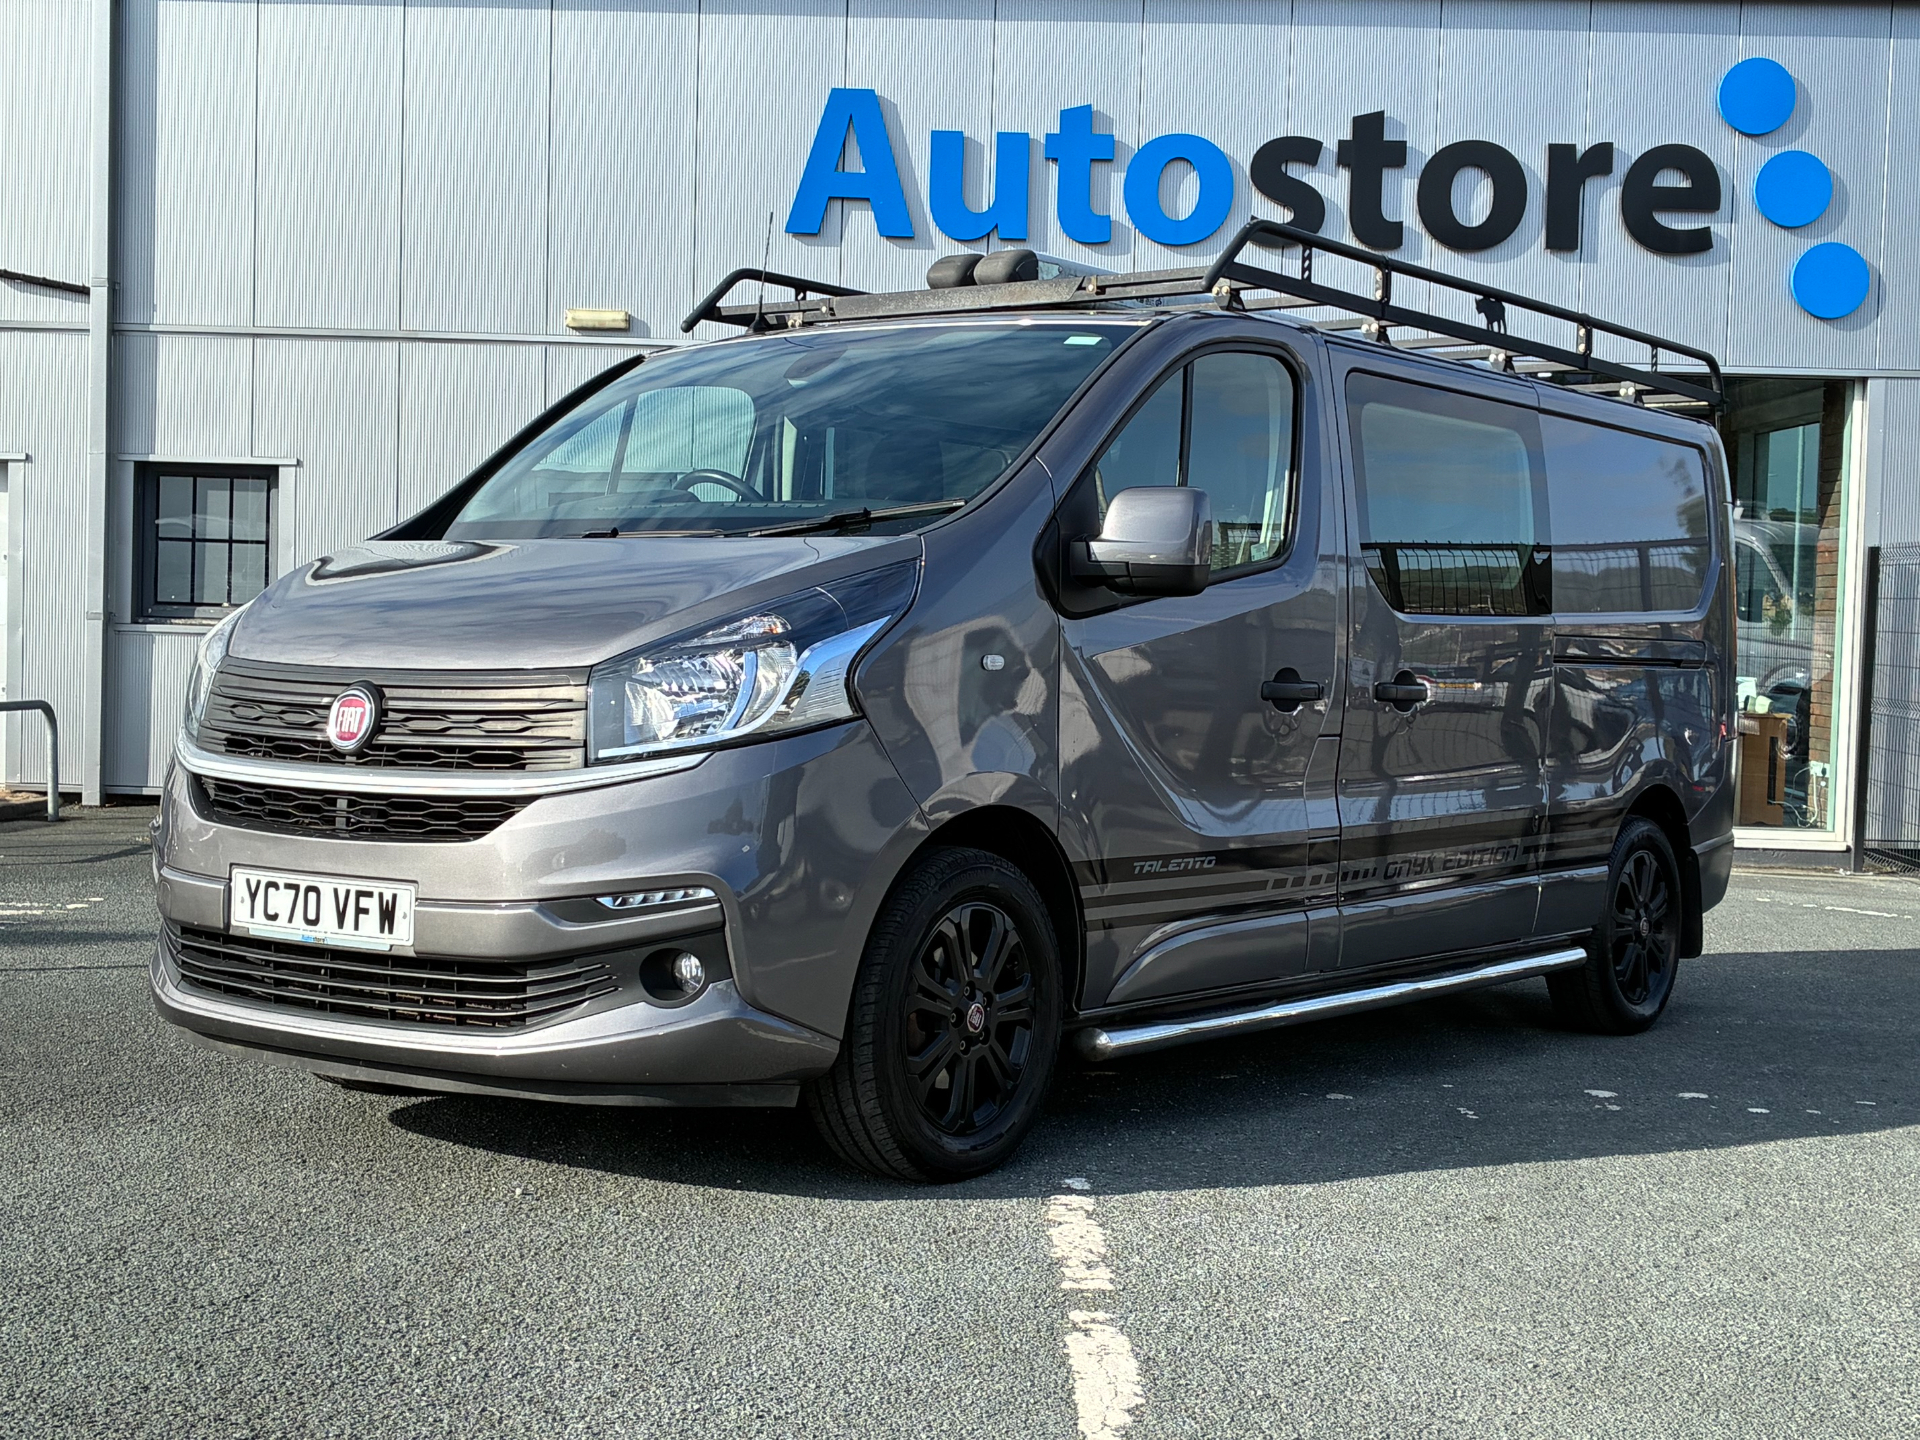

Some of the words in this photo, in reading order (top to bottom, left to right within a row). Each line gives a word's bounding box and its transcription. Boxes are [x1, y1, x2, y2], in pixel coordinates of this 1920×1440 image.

[785, 87, 1721, 253] Autostore
[337, 706, 364, 733] FIAT
[1133, 856, 1217, 875] TALENTO
[1383, 856, 1436, 880] ONYX
[1442, 844, 1519, 871] EDITION
[246, 878, 321, 927] YC70
[333, 887, 398, 935] VFW
